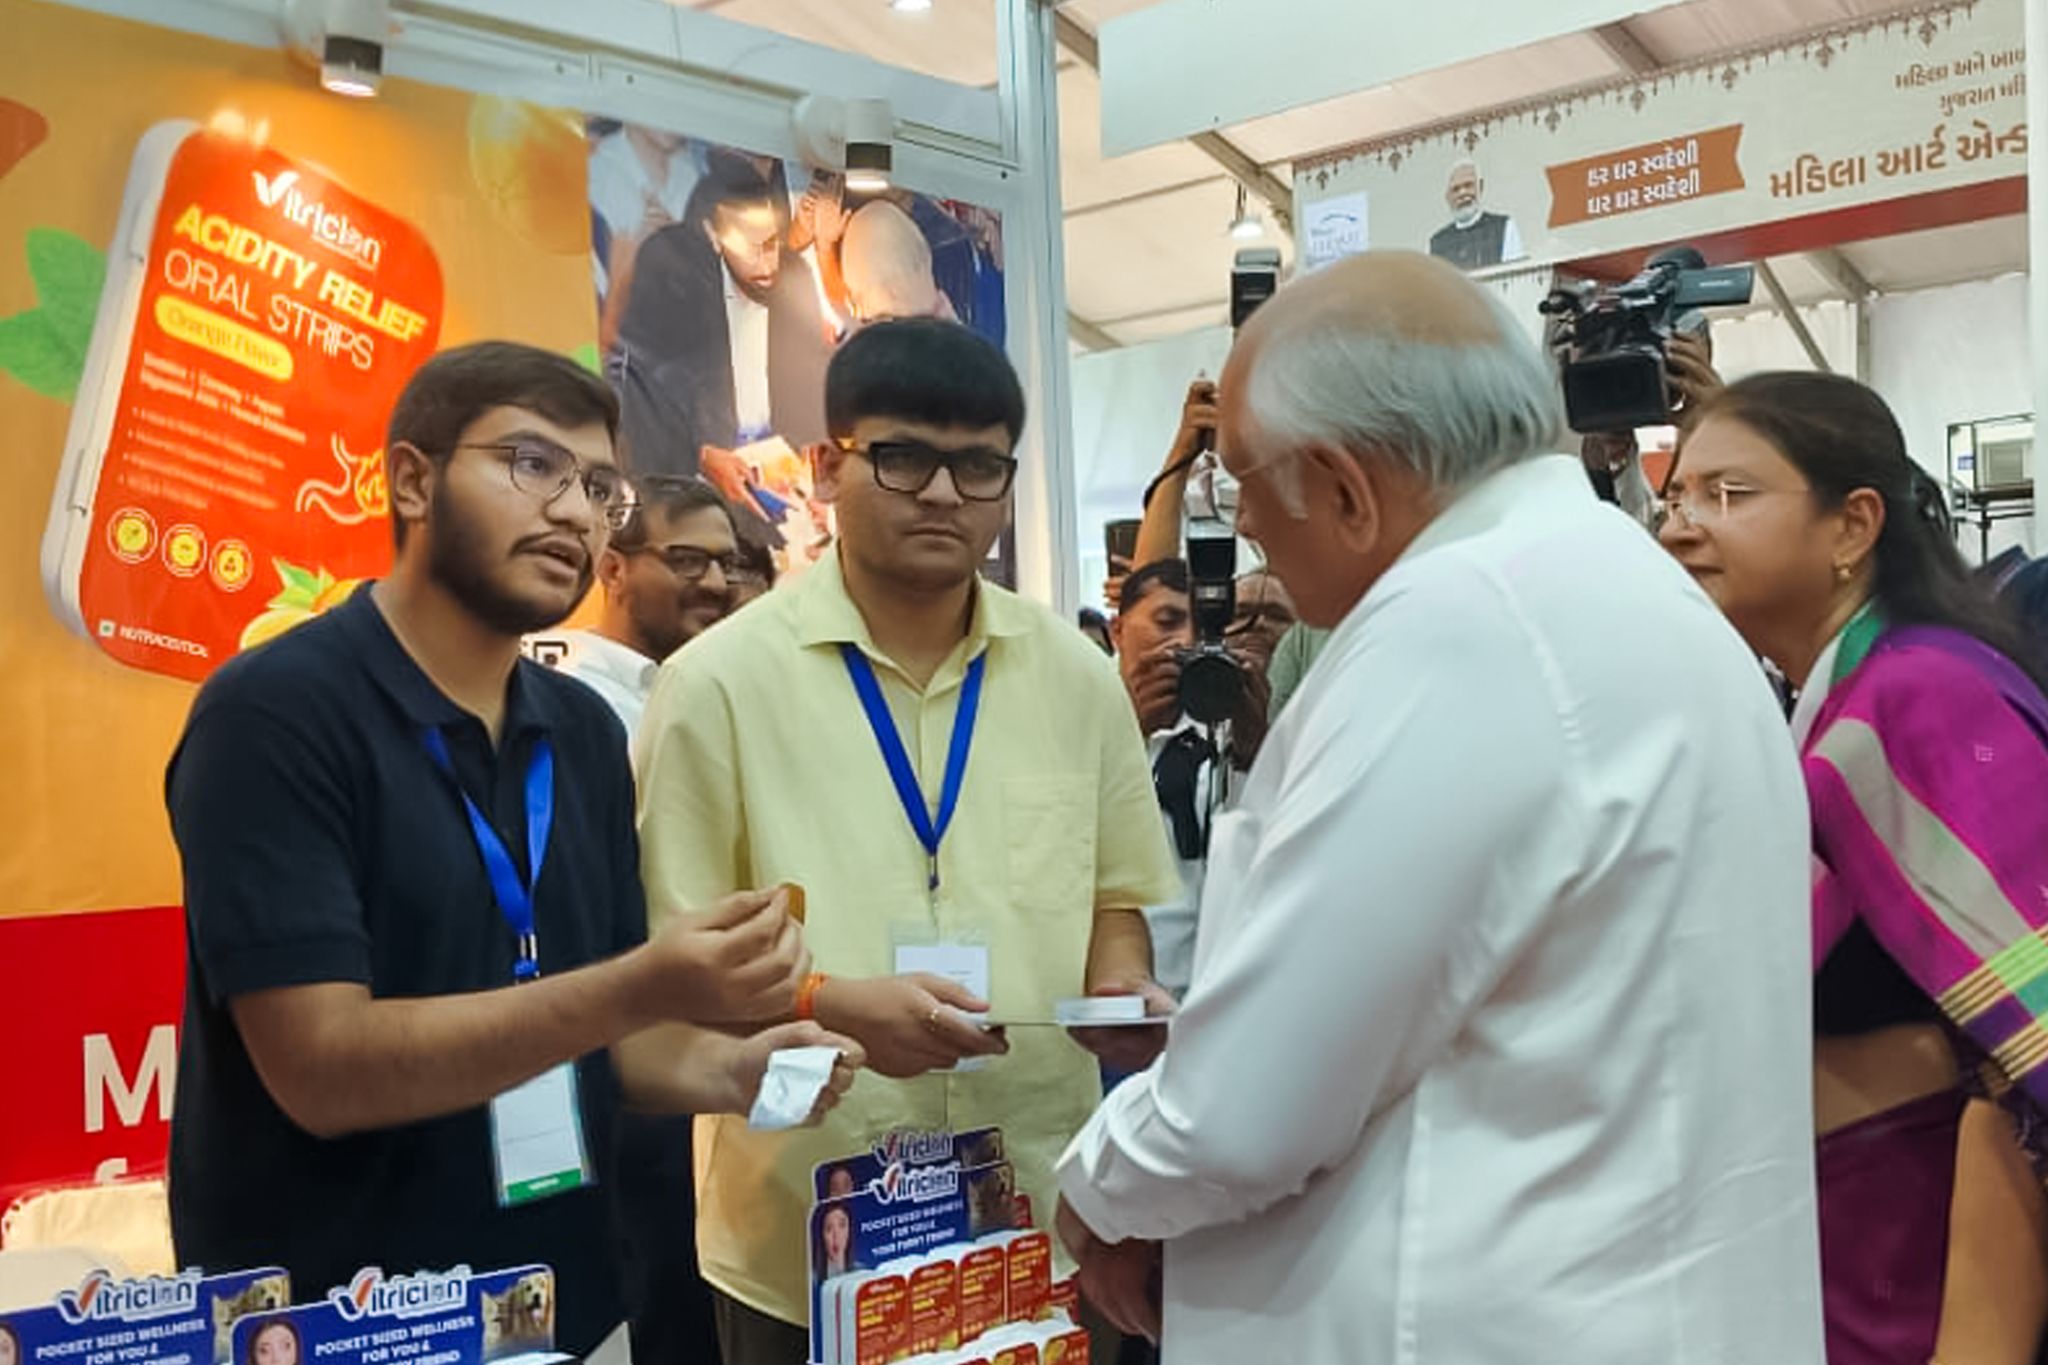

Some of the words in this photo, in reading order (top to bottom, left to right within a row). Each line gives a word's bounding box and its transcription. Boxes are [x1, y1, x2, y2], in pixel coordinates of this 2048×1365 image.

[1587, 168, 1609, 187] હર
[1613, 159, 1639, 181] ઘર
[1641, 138, 1699, 175] સ્વદેશી
[1587, 195, 1611, 214] ઘર
[1615, 188, 1639, 209] ઘર
[1643, 168, 1700, 203] સ્વદેશી
[1770, 153, 1866, 199] મહિલા
[1877, 123, 1947, 177] આર્ટ
[164, 248, 259, 322] ORAL
[267, 293, 374, 371] STRIPS
[173, 202, 317, 290] ACIDITY
[318, 269, 428, 342] RELIEF
